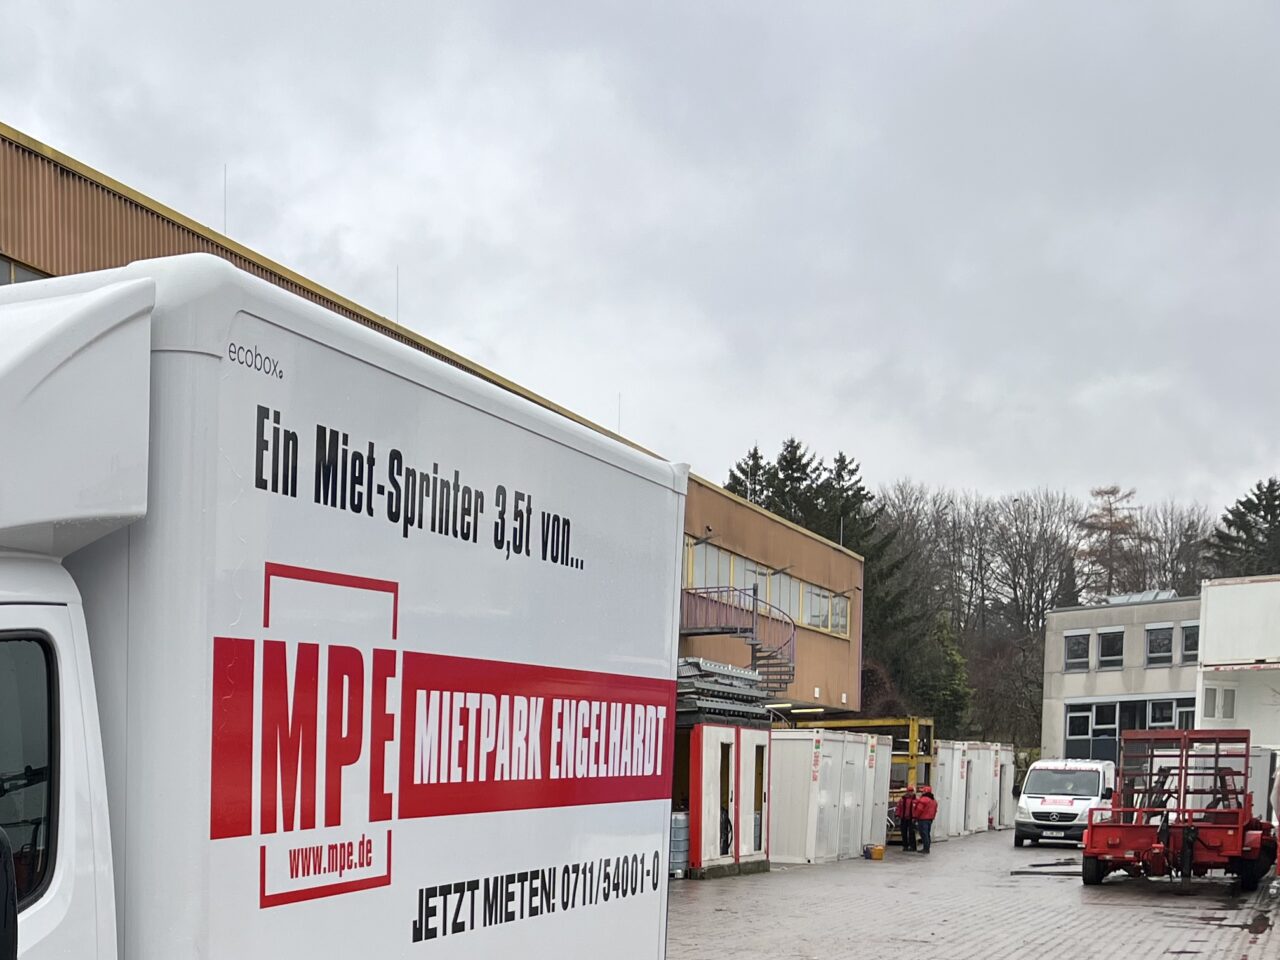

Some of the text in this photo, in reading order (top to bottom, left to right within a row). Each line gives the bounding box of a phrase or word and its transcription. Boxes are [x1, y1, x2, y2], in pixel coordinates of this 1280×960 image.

[255, 404, 584, 570] Ein Miet-Sprinter 3,5t von...
[260, 639, 397, 835] MPE
[413, 689, 667, 785] MIETPARK ENGELHARDT
[289, 834, 373, 879] www.mpe.de
[412, 849, 660, 943] JETZT MIETEN! 0711/54001-0
